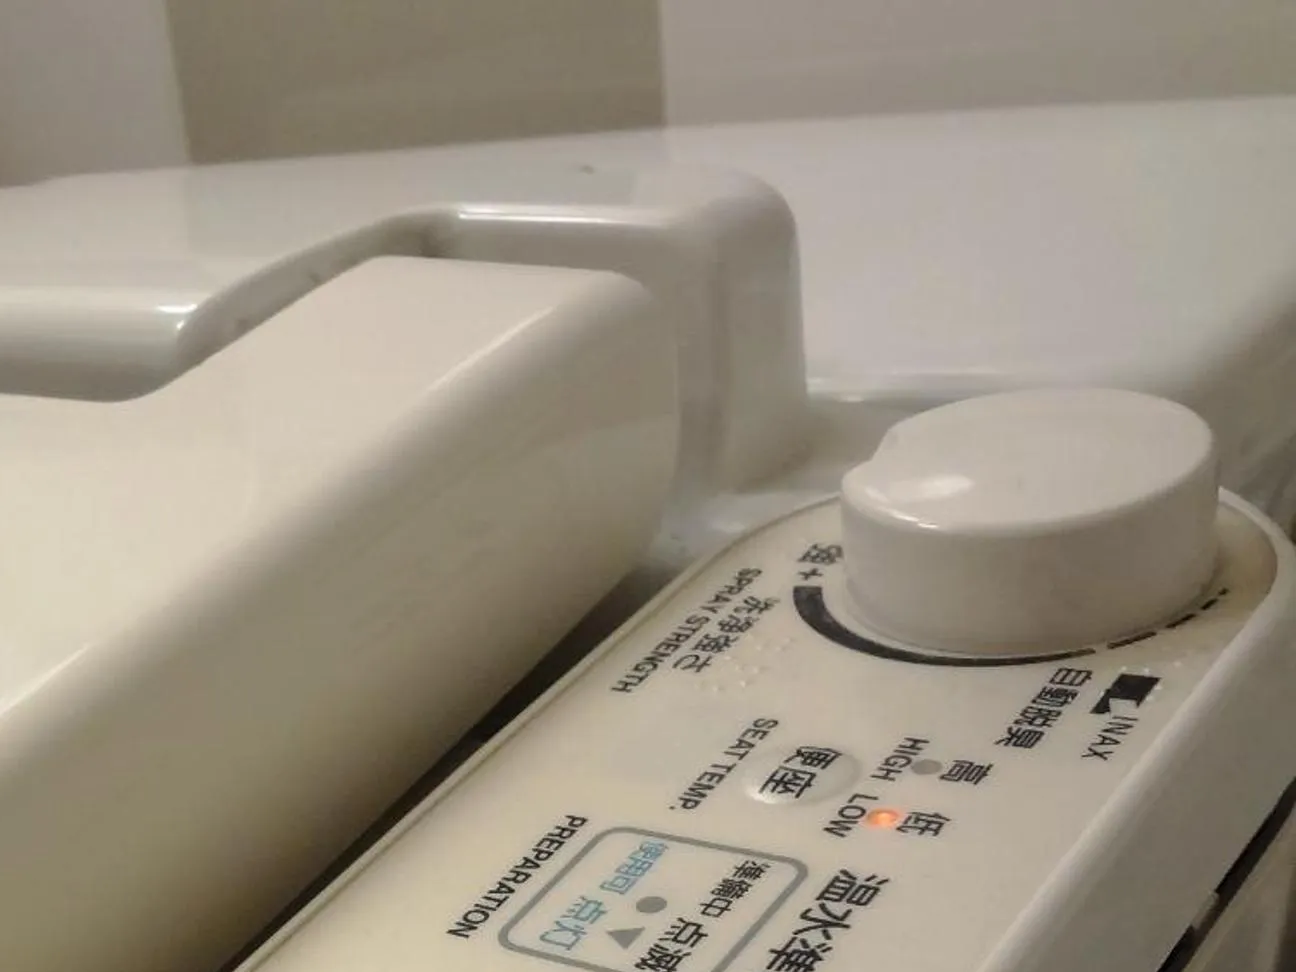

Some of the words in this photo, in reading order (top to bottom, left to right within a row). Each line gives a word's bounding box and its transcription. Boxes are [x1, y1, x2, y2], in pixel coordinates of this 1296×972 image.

[701, 568, 763, 614] SPRAY
[611, 614, 711, 693] STRENGTH
[672, 596, 780, 673] 洗浄強さ
[994, 667, 1093, 749] 自動脱臭
[726, 717, 779, 761] SEAT
[871, 736, 931, 782] HIGH
[1081, 715, 1139, 761] INAX
[668, 761, 738, 810] TEMP.
[758, 746, 843, 799] 便座
[939, 759, 995, 786] 高
[822, 792, 880, 838] LOW
[895, 811, 951, 837] 低
[447, 814, 589, 939] PREPARATION
